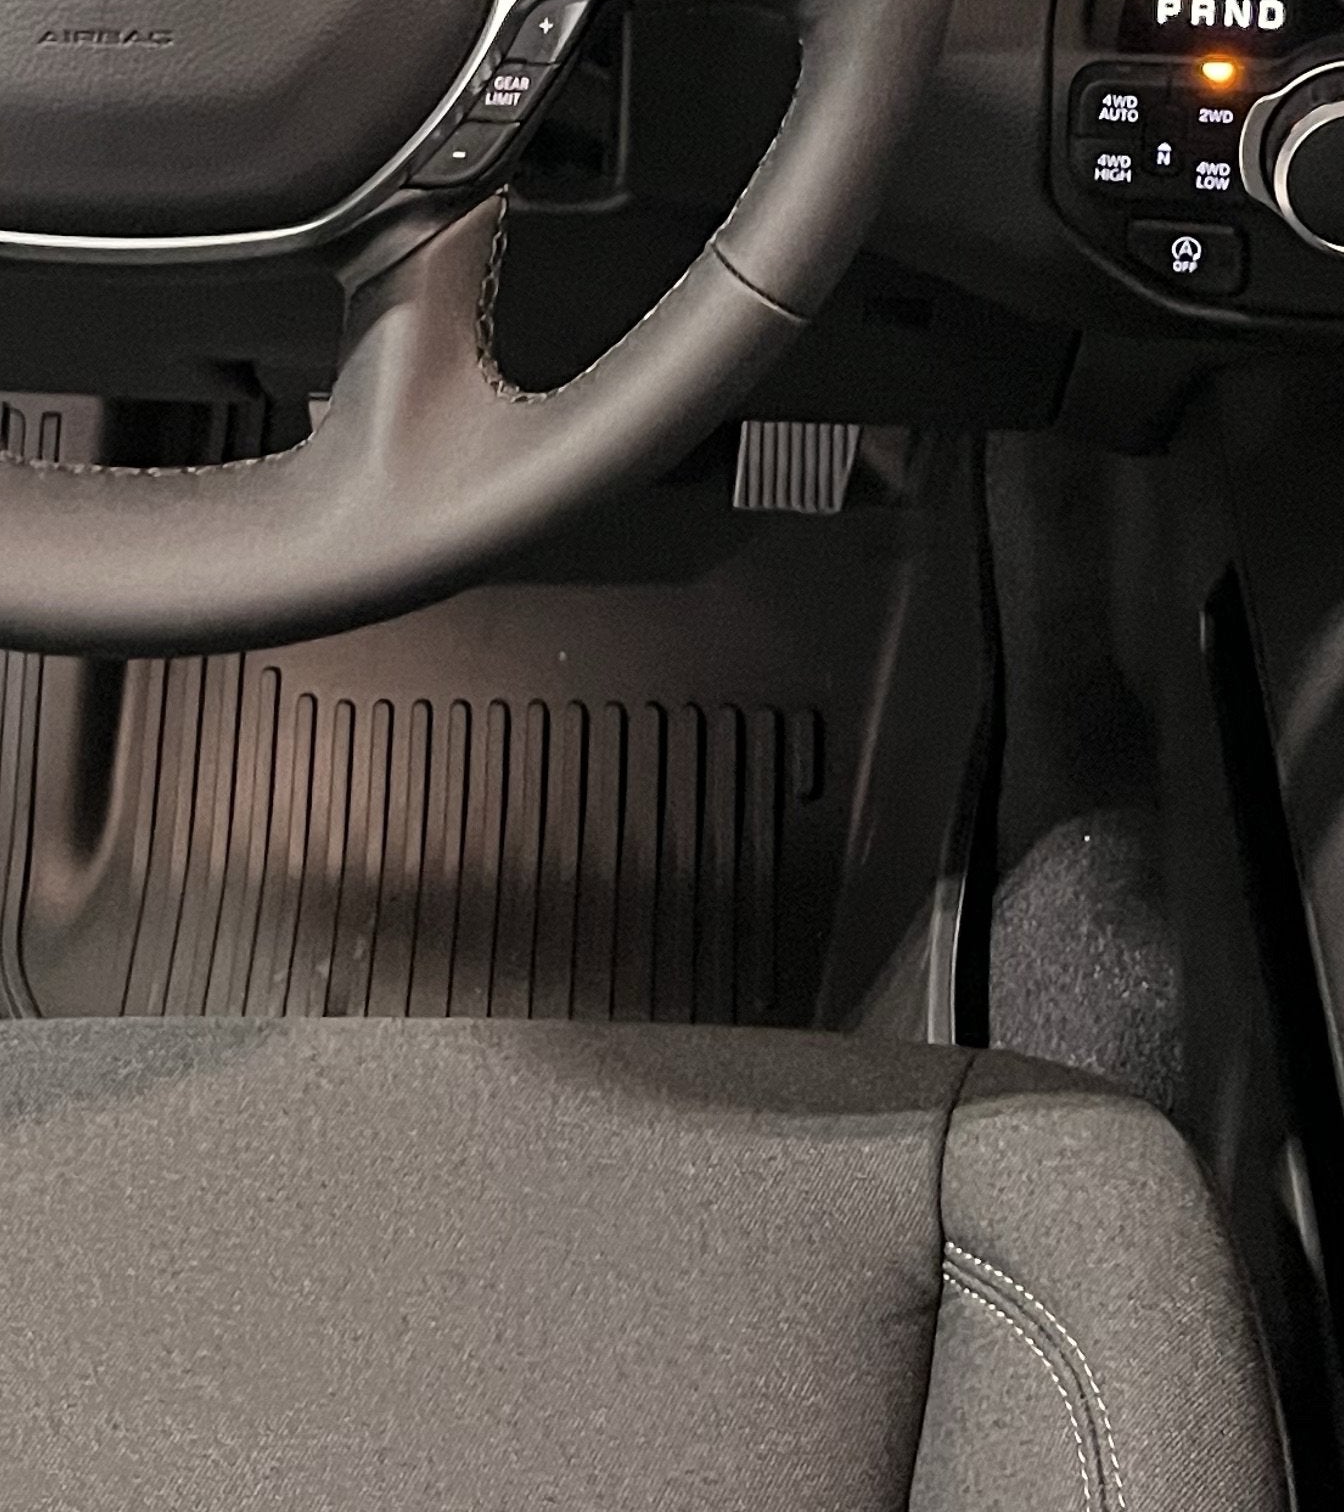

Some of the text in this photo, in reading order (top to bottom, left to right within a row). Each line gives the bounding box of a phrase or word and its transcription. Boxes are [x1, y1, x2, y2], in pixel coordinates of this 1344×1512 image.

[37, 29, 175, 46] AIRBAG
[494, 76, 529, 91] GEAR
[485, 92, 521, 106] LIMIT
[1102, 93, 1138, 108] 4WD
[1098, 108, 1139, 123] AUTO
[1198, 108, 1234, 124] 2WD
[1096, 153, 1132, 169] 4WD
[1157, 151, 1170, 166] N
[1094, 168, 1132, 183] HIGH
[1196, 161, 1231, 176] 4WD
[1196, 176, 1230, 191] LOW
[1172, 261, 1198, 273] OFF
